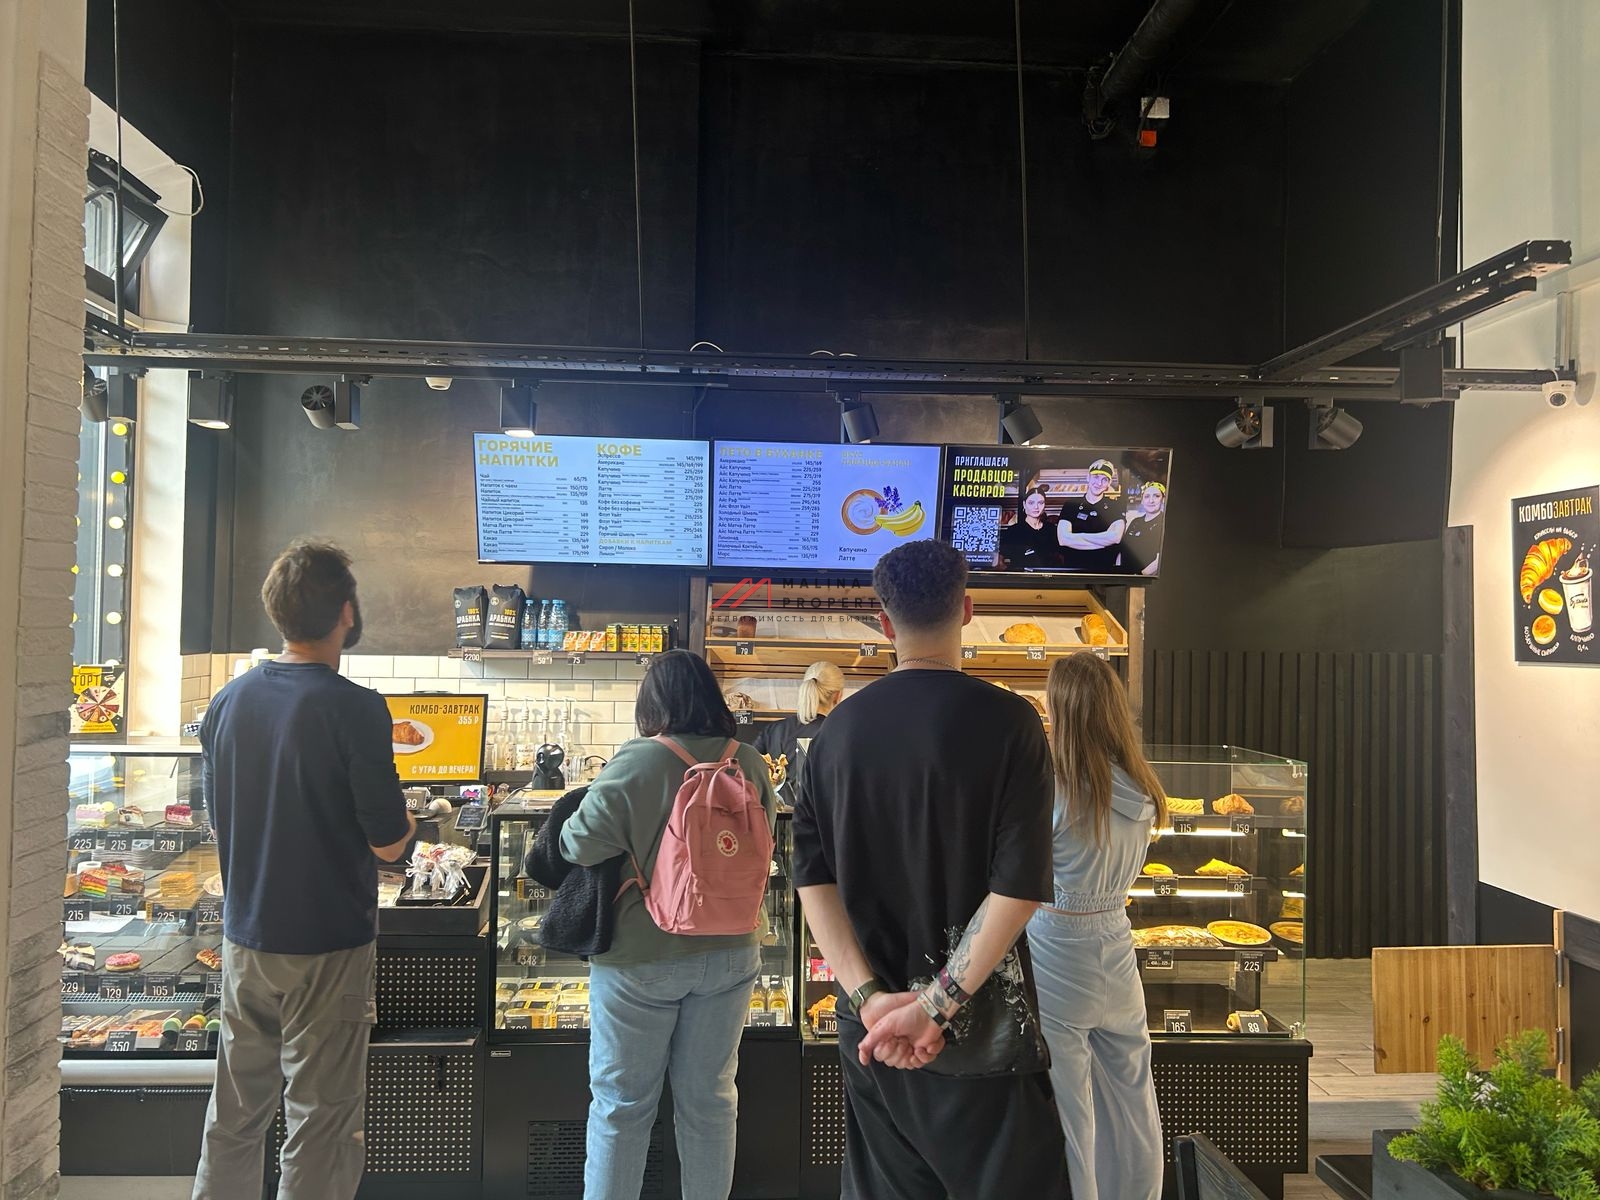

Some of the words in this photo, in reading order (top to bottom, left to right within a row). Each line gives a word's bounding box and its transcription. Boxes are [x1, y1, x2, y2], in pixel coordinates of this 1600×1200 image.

[478, 439, 553, 453] ГОРЯЧИЕ
[597, 444, 641, 456] КОФЕ
[479, 454, 559, 467] НАПИТКИ
[955, 456, 1008, 467] ПРИГЛАШАЕМ
[953, 485, 1005, 498] КАССИРОВ
[1519, 496, 1592, 523] КОМБОЗАВТРАК
[490, 614, 515, 624] АРАБИКА
[74, 674, 99, 686] ТОРТ
[410, 705, 479, 714] КОМБО-ЗАВТРАК
[419, 766, 436, 774] УТРА
[438, 766, 448, 774] ДО
[449, 765, 475, 774] ВЕЧЕРА!
[406, 799, 417, 808] 89
[1180, 823, 1192, 833] 115
[1236, 823, 1250, 833] 159
[74, 839, 92, 850] 225
[111, 840, 126, 850] 215
[160, 840, 176, 851] 219
[528, 889, 545, 898] 265
[1160, 885, 1171, 895] 85
[116, 904, 132, 914] 215
[68, 910, 84, 920] 215
[157, 912, 175, 922] 225
[203, 911, 219, 922] 275
[1244, 961, 1259, 971] 225
[61, 982, 78, 993] 229
[152, 986, 168, 996] 105
[213, 984, 222, 994] 13
[106, 988, 122, 999] 129
[825, 1020, 837, 1031] 110
[1171, 1022, 1185, 1032] 165
[1248, 1023, 1259, 1033] 89
[111, 1041, 130, 1051] 350
[185, 1040, 198, 1051] 95
